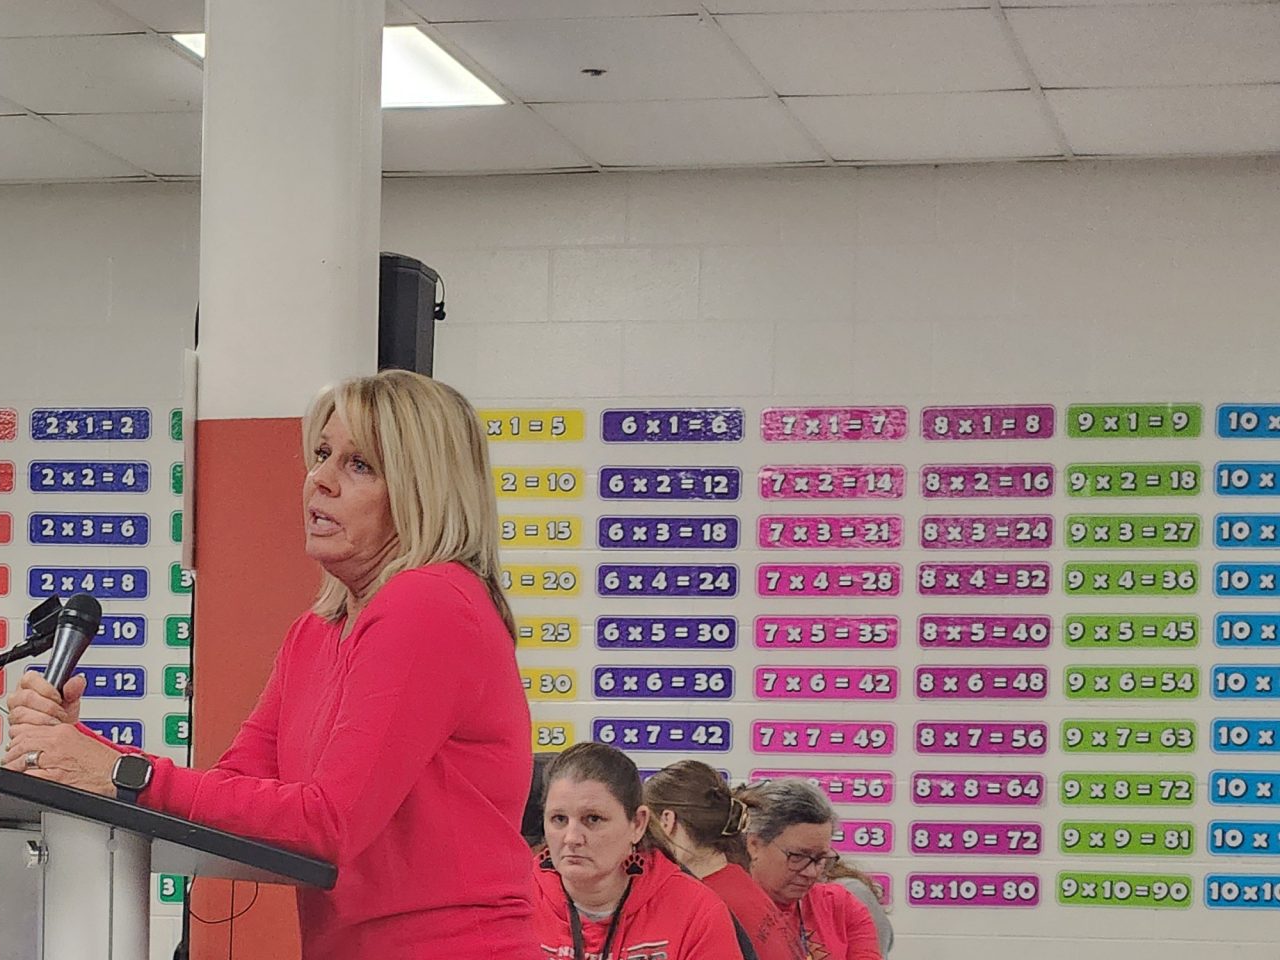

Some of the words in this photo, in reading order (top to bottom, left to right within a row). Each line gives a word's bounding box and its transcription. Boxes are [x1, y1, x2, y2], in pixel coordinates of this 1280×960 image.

[46, 416, 59, 435] 2
[65, 420, 79, 434] x
[85, 416, 94, 434] 1
[120, 416, 134, 434] 2
[41, 468, 55, 486] 2
[62, 471, 75, 486] x
[81, 468, 95, 486] 2
[121, 468, 135, 486] 4
[502, 473, 516, 490] 2
[548, 473, 575, 491] 10
[608, 474, 625, 493] 6
[633, 478, 648, 493] x
[656, 474, 672, 493] 2
[703, 475, 729, 493] 12
[925, 472, 940, 491] 8
[948, 476, 965, 491] x
[974, 472, 989, 491] 2
[1022, 472, 1049, 490] 16
[1070, 472, 1086, 490] 9
[1096, 475, 1110, 490] x
[1120, 471, 1136, 489] 2
[1170, 470, 1196, 489] 18
[41, 518, 55, 536] 2
[61, 522, 74, 536] x
[81, 519, 94, 537] 3
[120, 519, 135, 537] 6
[608, 522, 624, 541] 6
[632, 526, 647, 541] x
[655, 523, 670, 541] 3
[701, 522, 727, 542] 18
[1070, 523, 1086, 541] 9
[1094, 526, 1109, 540] x
[1119, 523, 1133, 541] 3
[1163, 522, 1194, 541] 27
[1220, 521, 1250, 540] 10
[1259, 525, 1275, 540] x
[41, 573, 55, 591] 2
[61, 576, 74, 591] x
[81, 573, 95, 591] 4
[121, 573, 134, 592] 8
[604, 571, 620, 590] 6
[628, 575, 643, 590] x
[651, 571, 668, 590] 4
[699, 572, 731, 590] 24
[763, 623, 778, 642] 7
[785, 627, 802, 642] x
[810, 623, 825, 642] 5
[858, 623, 890, 642] 35
[114, 672, 137, 691] 12
[599, 672, 615, 691] 6
[623, 676, 638, 691] x
[646, 672, 663, 691] 6
[693, 673, 725, 691] 36
[762, 672, 777, 691] 7
[785, 676, 801, 691] x
[810, 673, 826, 692] 6
[858, 673, 890, 692] 42
[919, 673, 934, 692] 8
[943, 676, 958, 691] x
[967, 673, 984, 692] 6
[1012, 672, 1044, 691] 48
[1068, 672, 1084, 691] 9
[1094, 676, 1109, 691] x
[1119, 672, 1135, 691] 6
[1161, 673, 1193, 691] 54
[599, 724, 616, 743] 6
[623, 728, 639, 743] x
[646, 725, 661, 744] 7
[691, 725, 723, 744] 42
[759, 727, 774, 746] 7
[782, 731, 798, 746] x
[806, 728, 821, 746] 7
[853, 728, 886, 747] 49
[920, 727, 935, 746] 8
[943, 731, 959, 746] x
[967, 728, 982, 747] 7
[1011, 729, 1044, 747] 56
[1064, 779, 1080, 798] 9
[1090, 783, 1105, 798] x
[1114, 780, 1129, 798] 8
[1159, 780, 1190, 798] 72
[1216, 778, 1247, 797] 10
[1256, 782, 1272, 797] x
[914, 829, 929, 848] 8
[938, 833, 953, 848] x
[962, 829, 979, 848] 9
[1007, 830, 1038, 849] 72
[1063, 828, 1080, 846] 9
[1089, 832, 1104, 847] x
[1114, 829, 1130, 847] 9
[1164, 830, 1189, 848] 81
